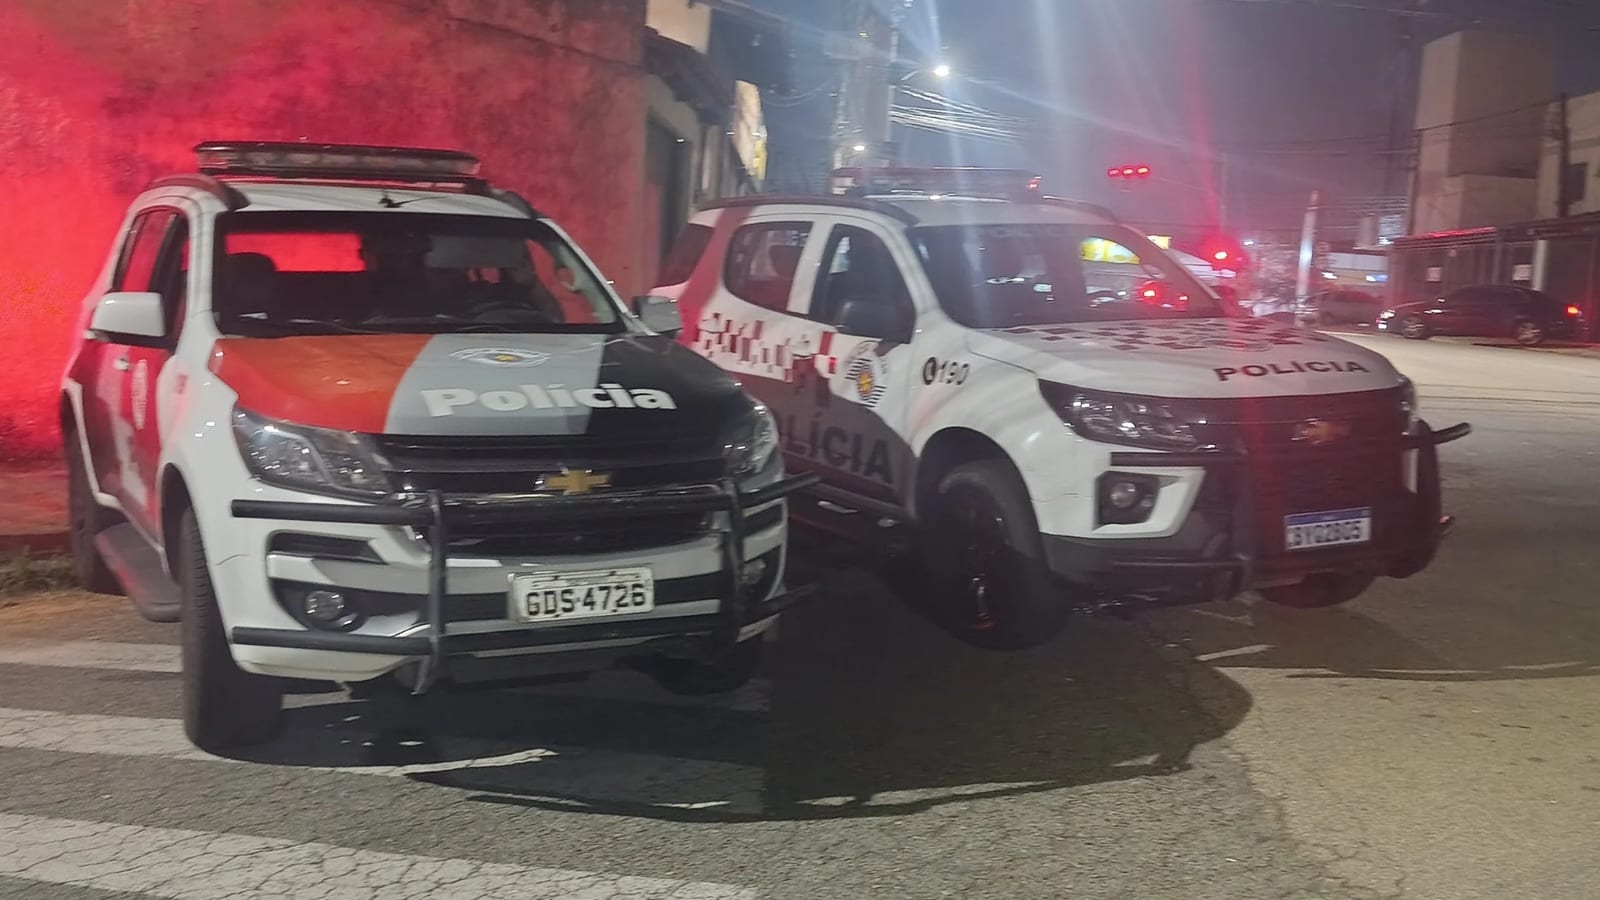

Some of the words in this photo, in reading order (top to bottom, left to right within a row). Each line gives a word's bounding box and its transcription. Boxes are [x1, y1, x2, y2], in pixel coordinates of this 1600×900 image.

[1213, 360, 1371, 382] POLÍCIA
[420, 382, 678, 418] Polícia
[780, 409, 893, 485] LÍCIA
